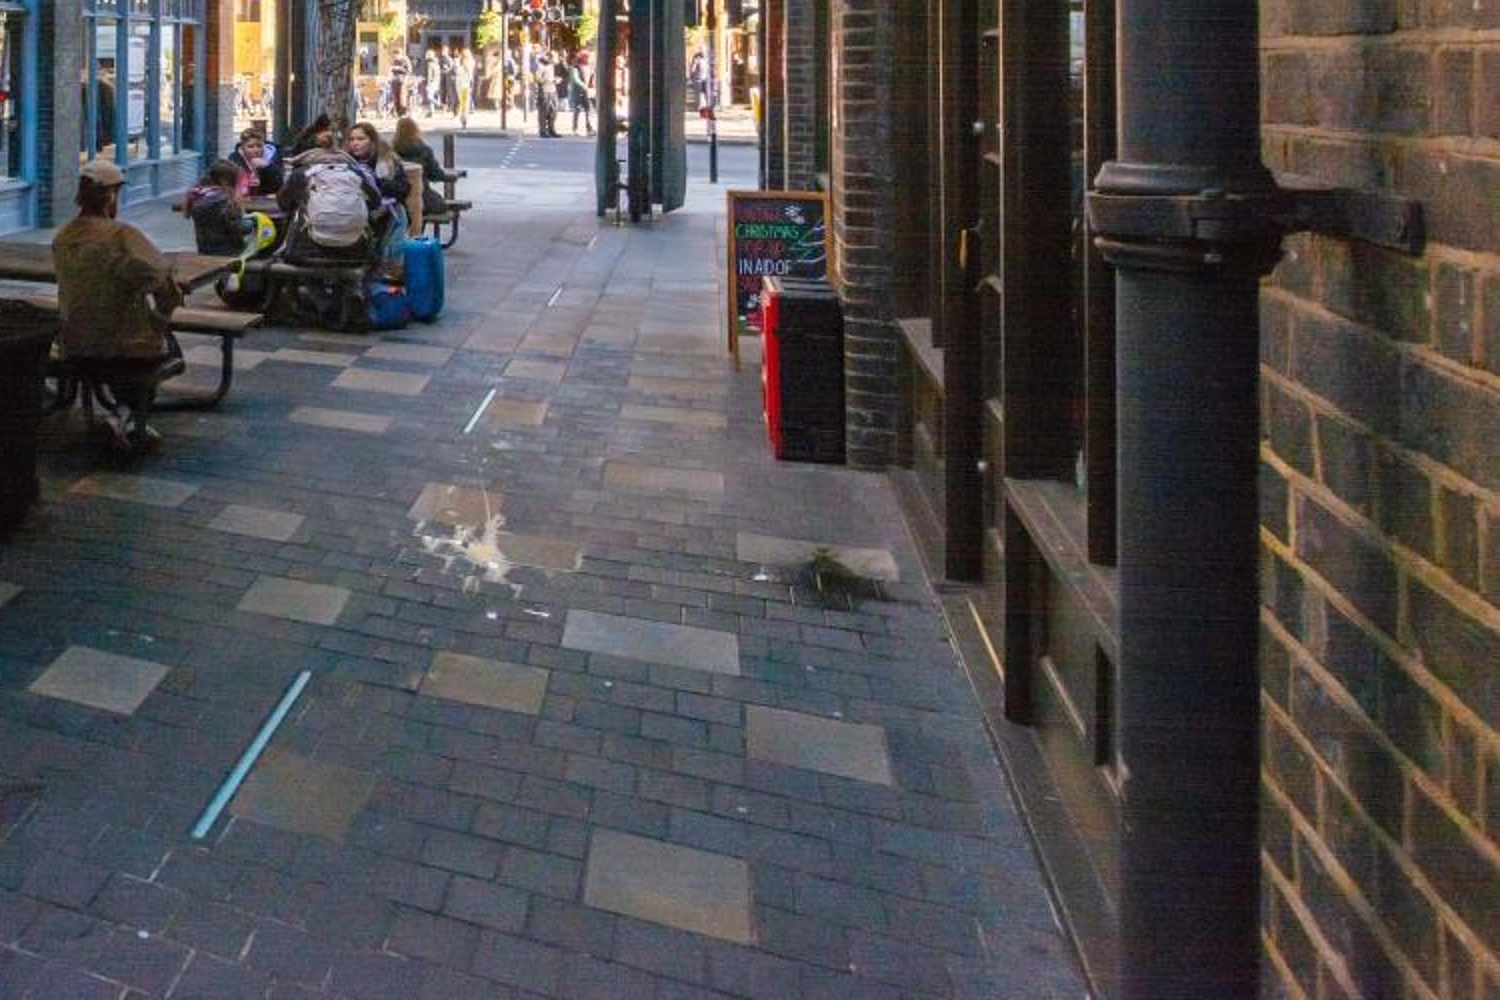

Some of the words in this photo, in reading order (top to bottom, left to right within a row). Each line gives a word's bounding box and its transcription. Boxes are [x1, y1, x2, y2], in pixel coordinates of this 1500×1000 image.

[735, 223, 800, 239] CHRISTMAS
[739, 258, 752, 275] IN
[754, 258, 774, 275] AID
[775, 257, 793, 275] OF
